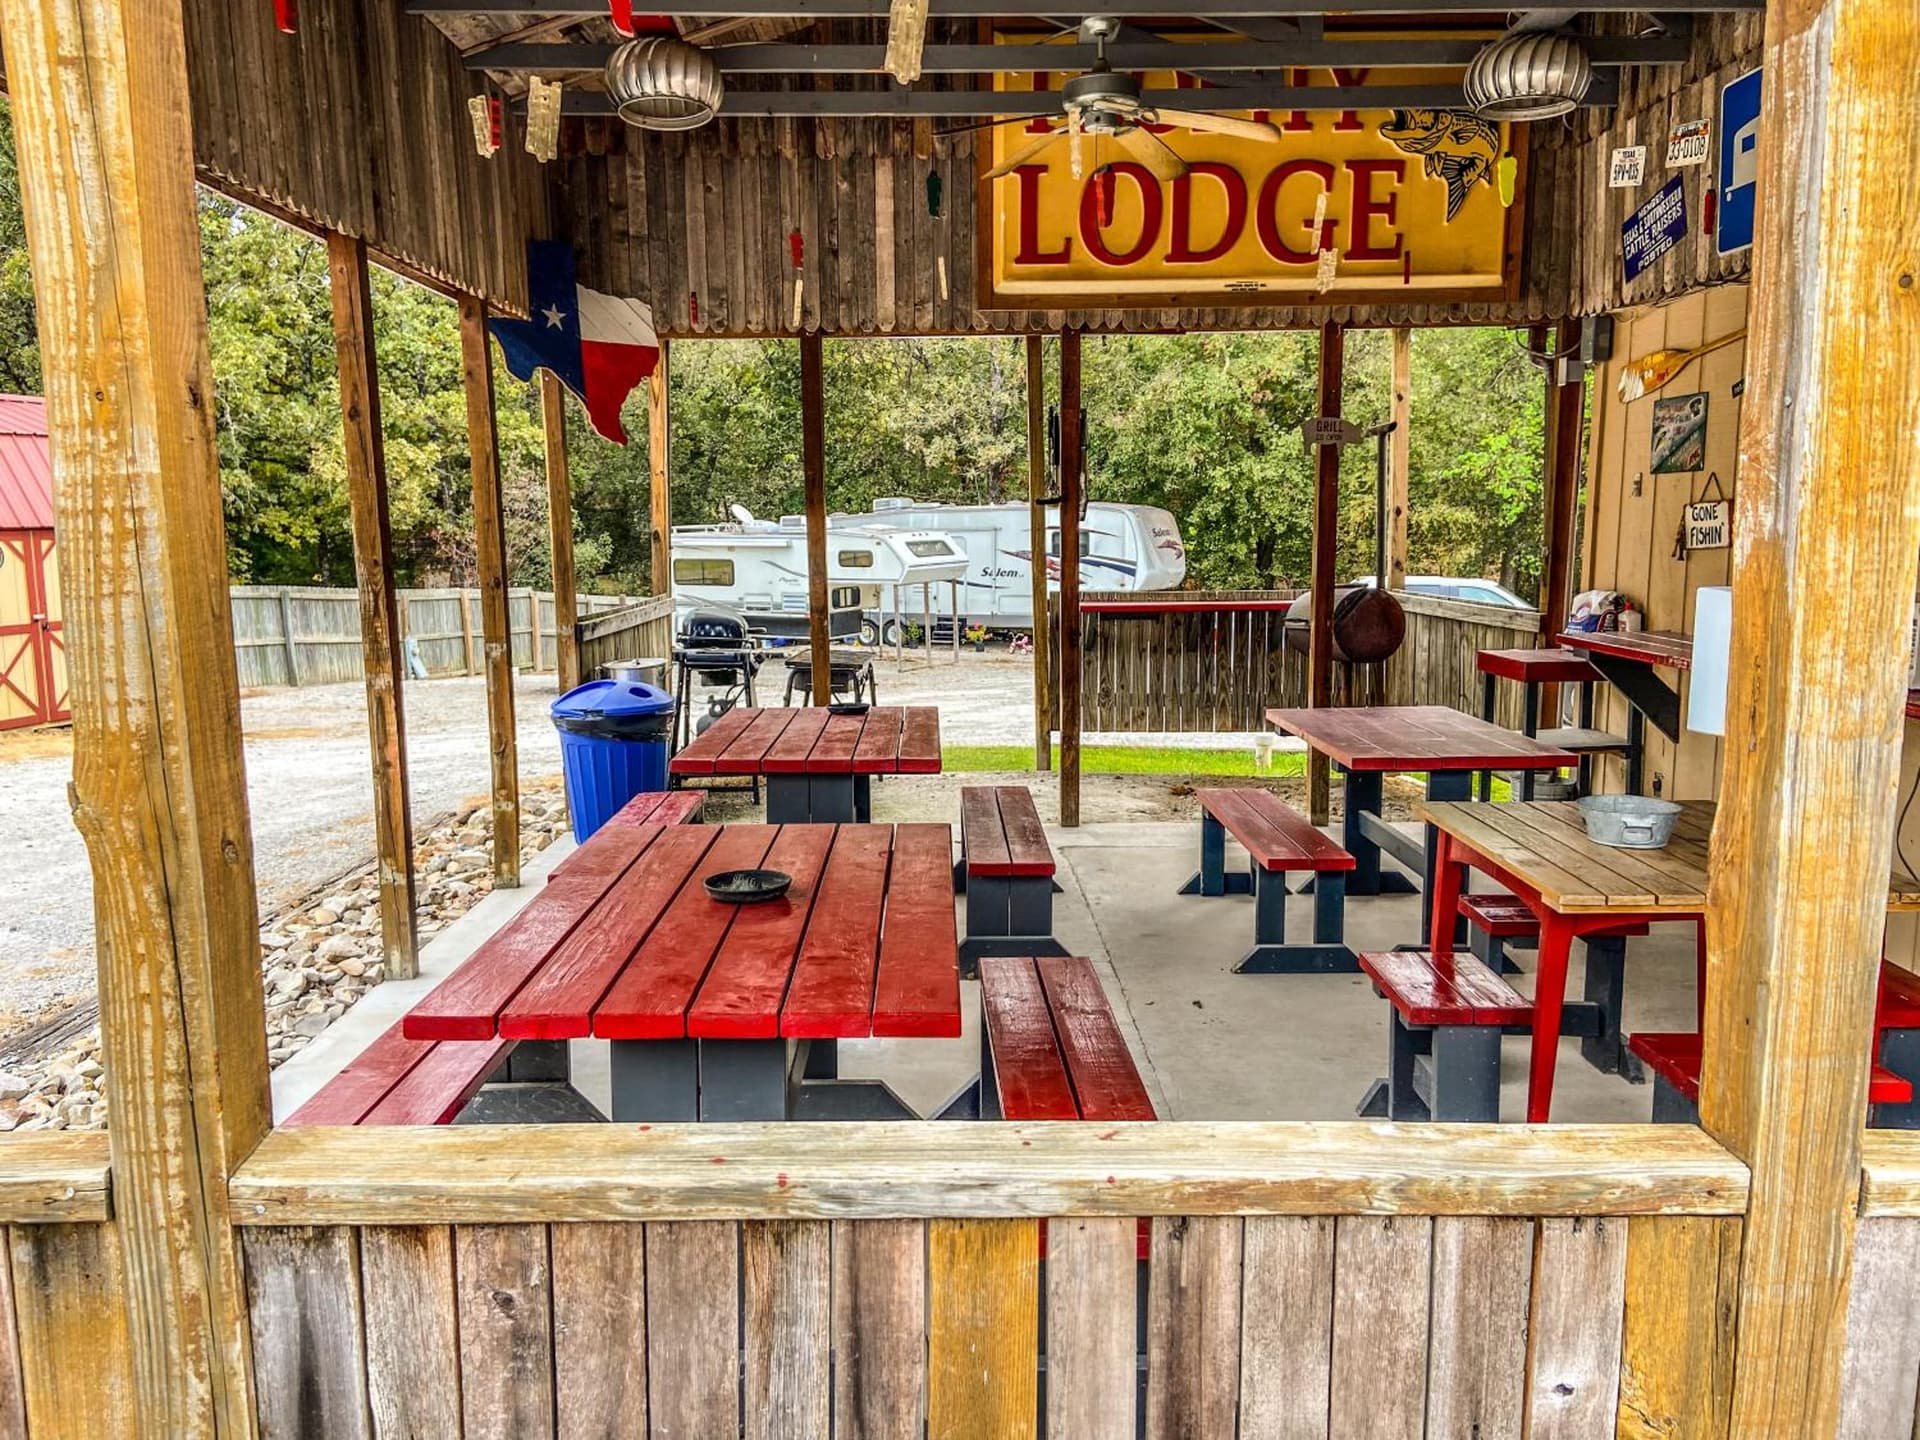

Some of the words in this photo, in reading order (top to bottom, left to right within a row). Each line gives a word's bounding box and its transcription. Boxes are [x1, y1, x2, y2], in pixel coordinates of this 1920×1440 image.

[1013, 158, 1407, 267] LODGE
[1623, 224, 1639, 247] TEXAS
[1643, 185, 1683, 230] SOUTHWESTERN
[1638, 190, 1665, 219] MEMBER
[1625, 229, 1650, 260] CATTLE
[1651, 201, 1683, 238] RAISERS
[1638, 236, 1673, 271] POSTED
[1316, 420, 1344, 433] GRILL
[1691, 504, 1719, 521] GONE
[1690, 521, 1725, 546] FISHIN'
[980, 566, 1018, 577] Salem
